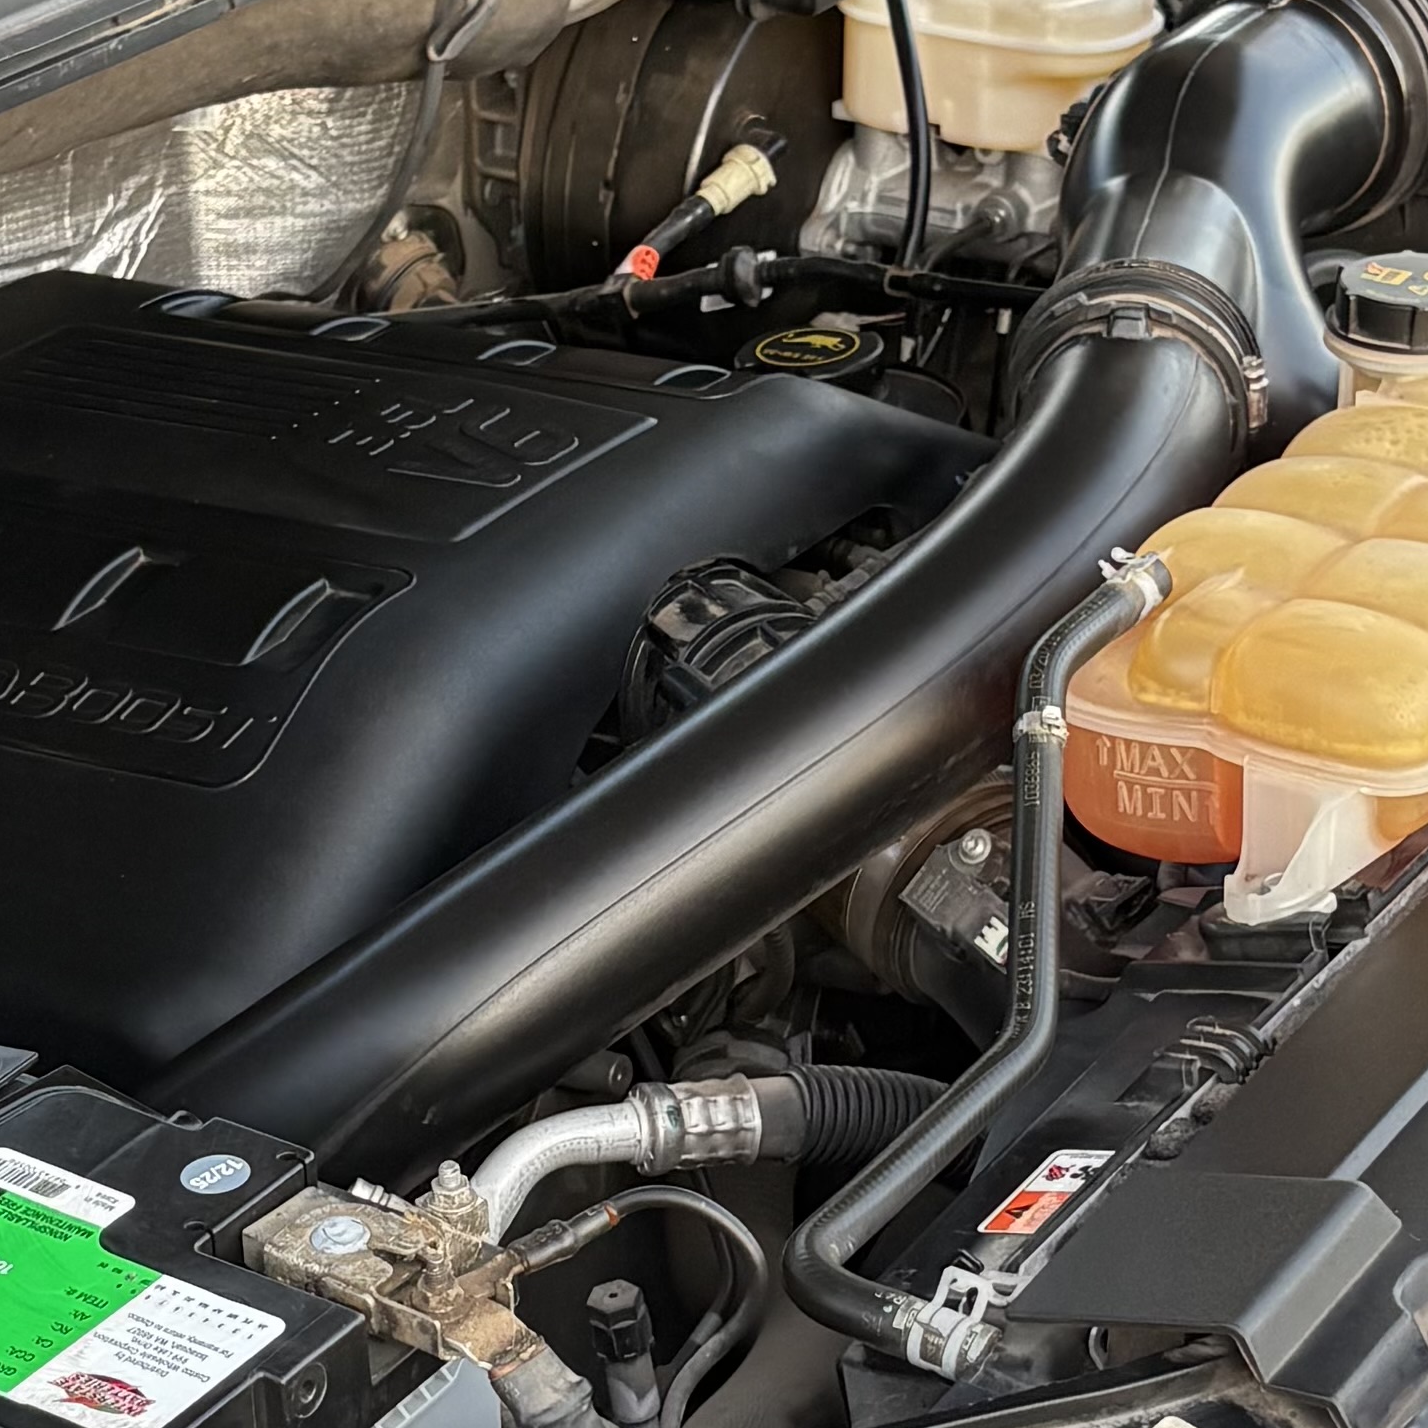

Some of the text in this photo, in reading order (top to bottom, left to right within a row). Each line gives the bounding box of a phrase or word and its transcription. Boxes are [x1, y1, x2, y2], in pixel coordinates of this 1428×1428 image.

[1115, 738, 1197, 779] MAX
[1117, 780, 1198, 822] MIN
[189, 1158, 243, 1190] 12/25
[17, 1205, 95, 1238] MAINTENANCE
[74, 1291, 109, 1308] ITEM
[67, 1308, 91, 1322] Ah:
[29, 1334, 54, 1348] CA:
[89, 1331, 141, 1355] Corporation
[152, 1335, 169, 1345] WA
[3, 1345, 36, 1362] CCA:
[111, 1350, 126, 1360] by
[217, 1348, 234, 1358] For
[179, 1367, 211, 1383] Costco
[48, 1375, 147, 1419] INTERSTATE
[65, 1369, 156, 1410] BATTERIES
